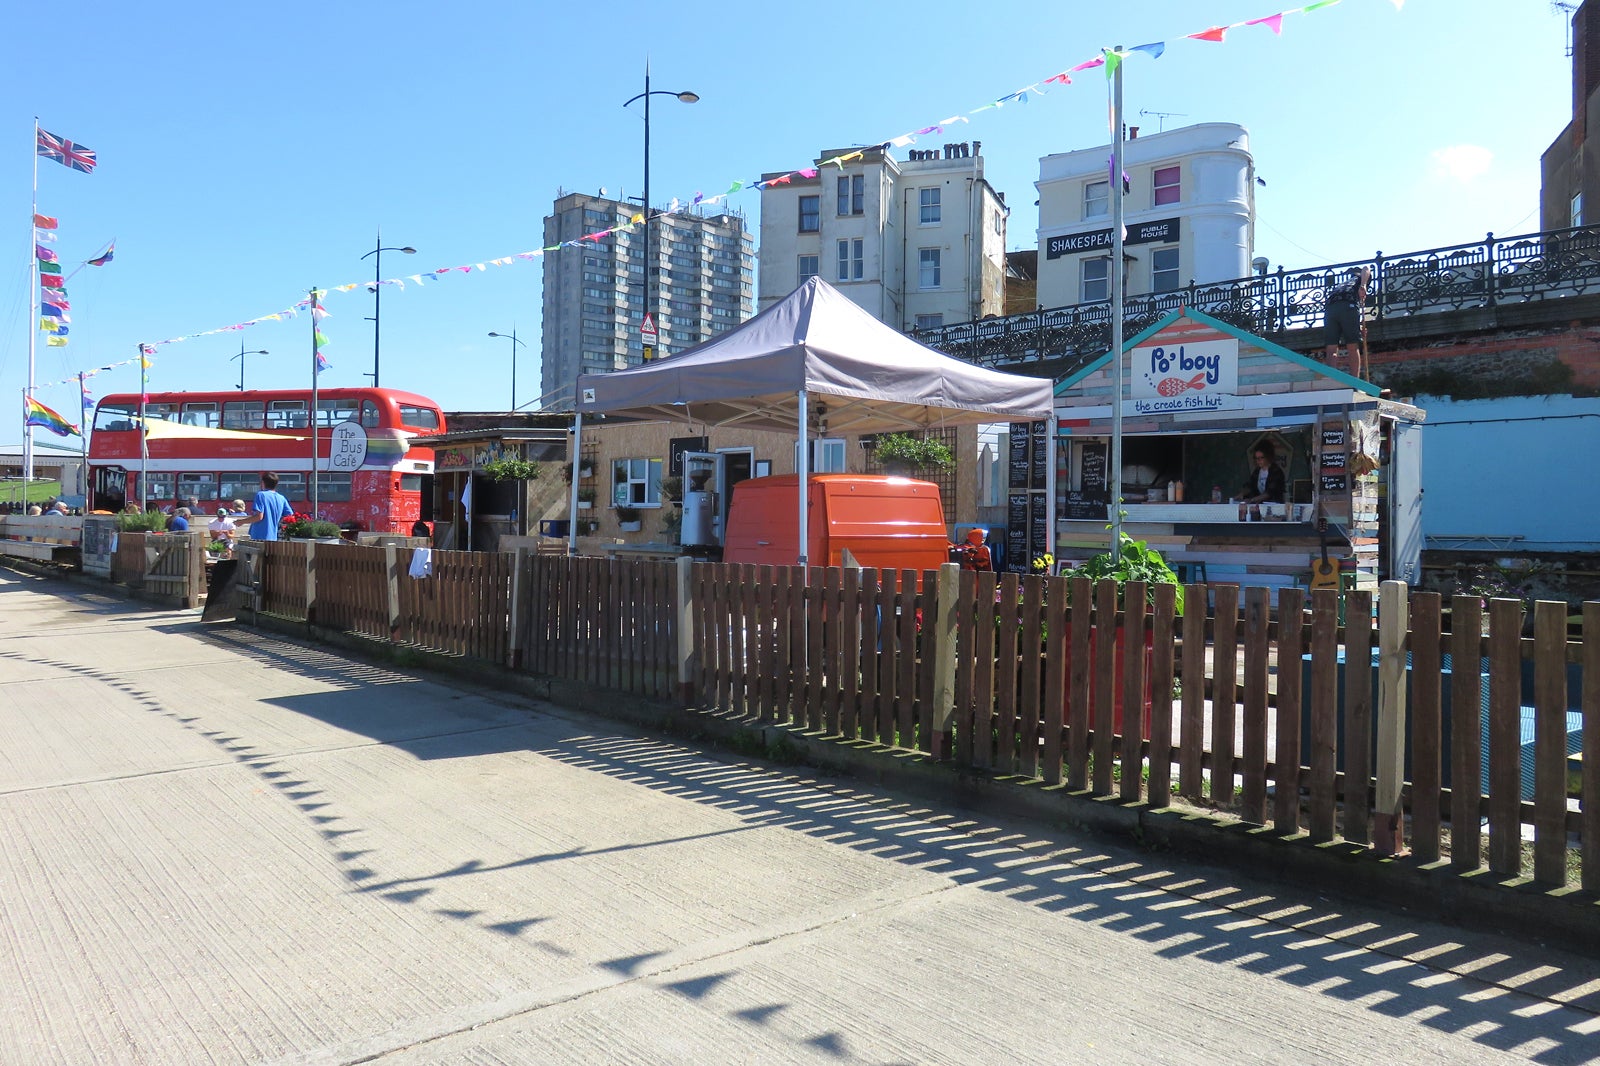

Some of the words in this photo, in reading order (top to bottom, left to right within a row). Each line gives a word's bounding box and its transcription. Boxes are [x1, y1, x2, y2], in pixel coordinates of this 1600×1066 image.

[1141, 224, 1169, 233] PUBLIC
[1141, 230, 1169, 239] HOUSE
[1135, 400, 1151, 411] the
[1154, 400, 1183, 410] creole
[1184, 397, 1203, 408] fish
[1205, 395, 1223, 406] hut
[338, 428, 356, 438] The
[341, 440, 362, 453] Bus
[334, 454, 356, 467] Café
